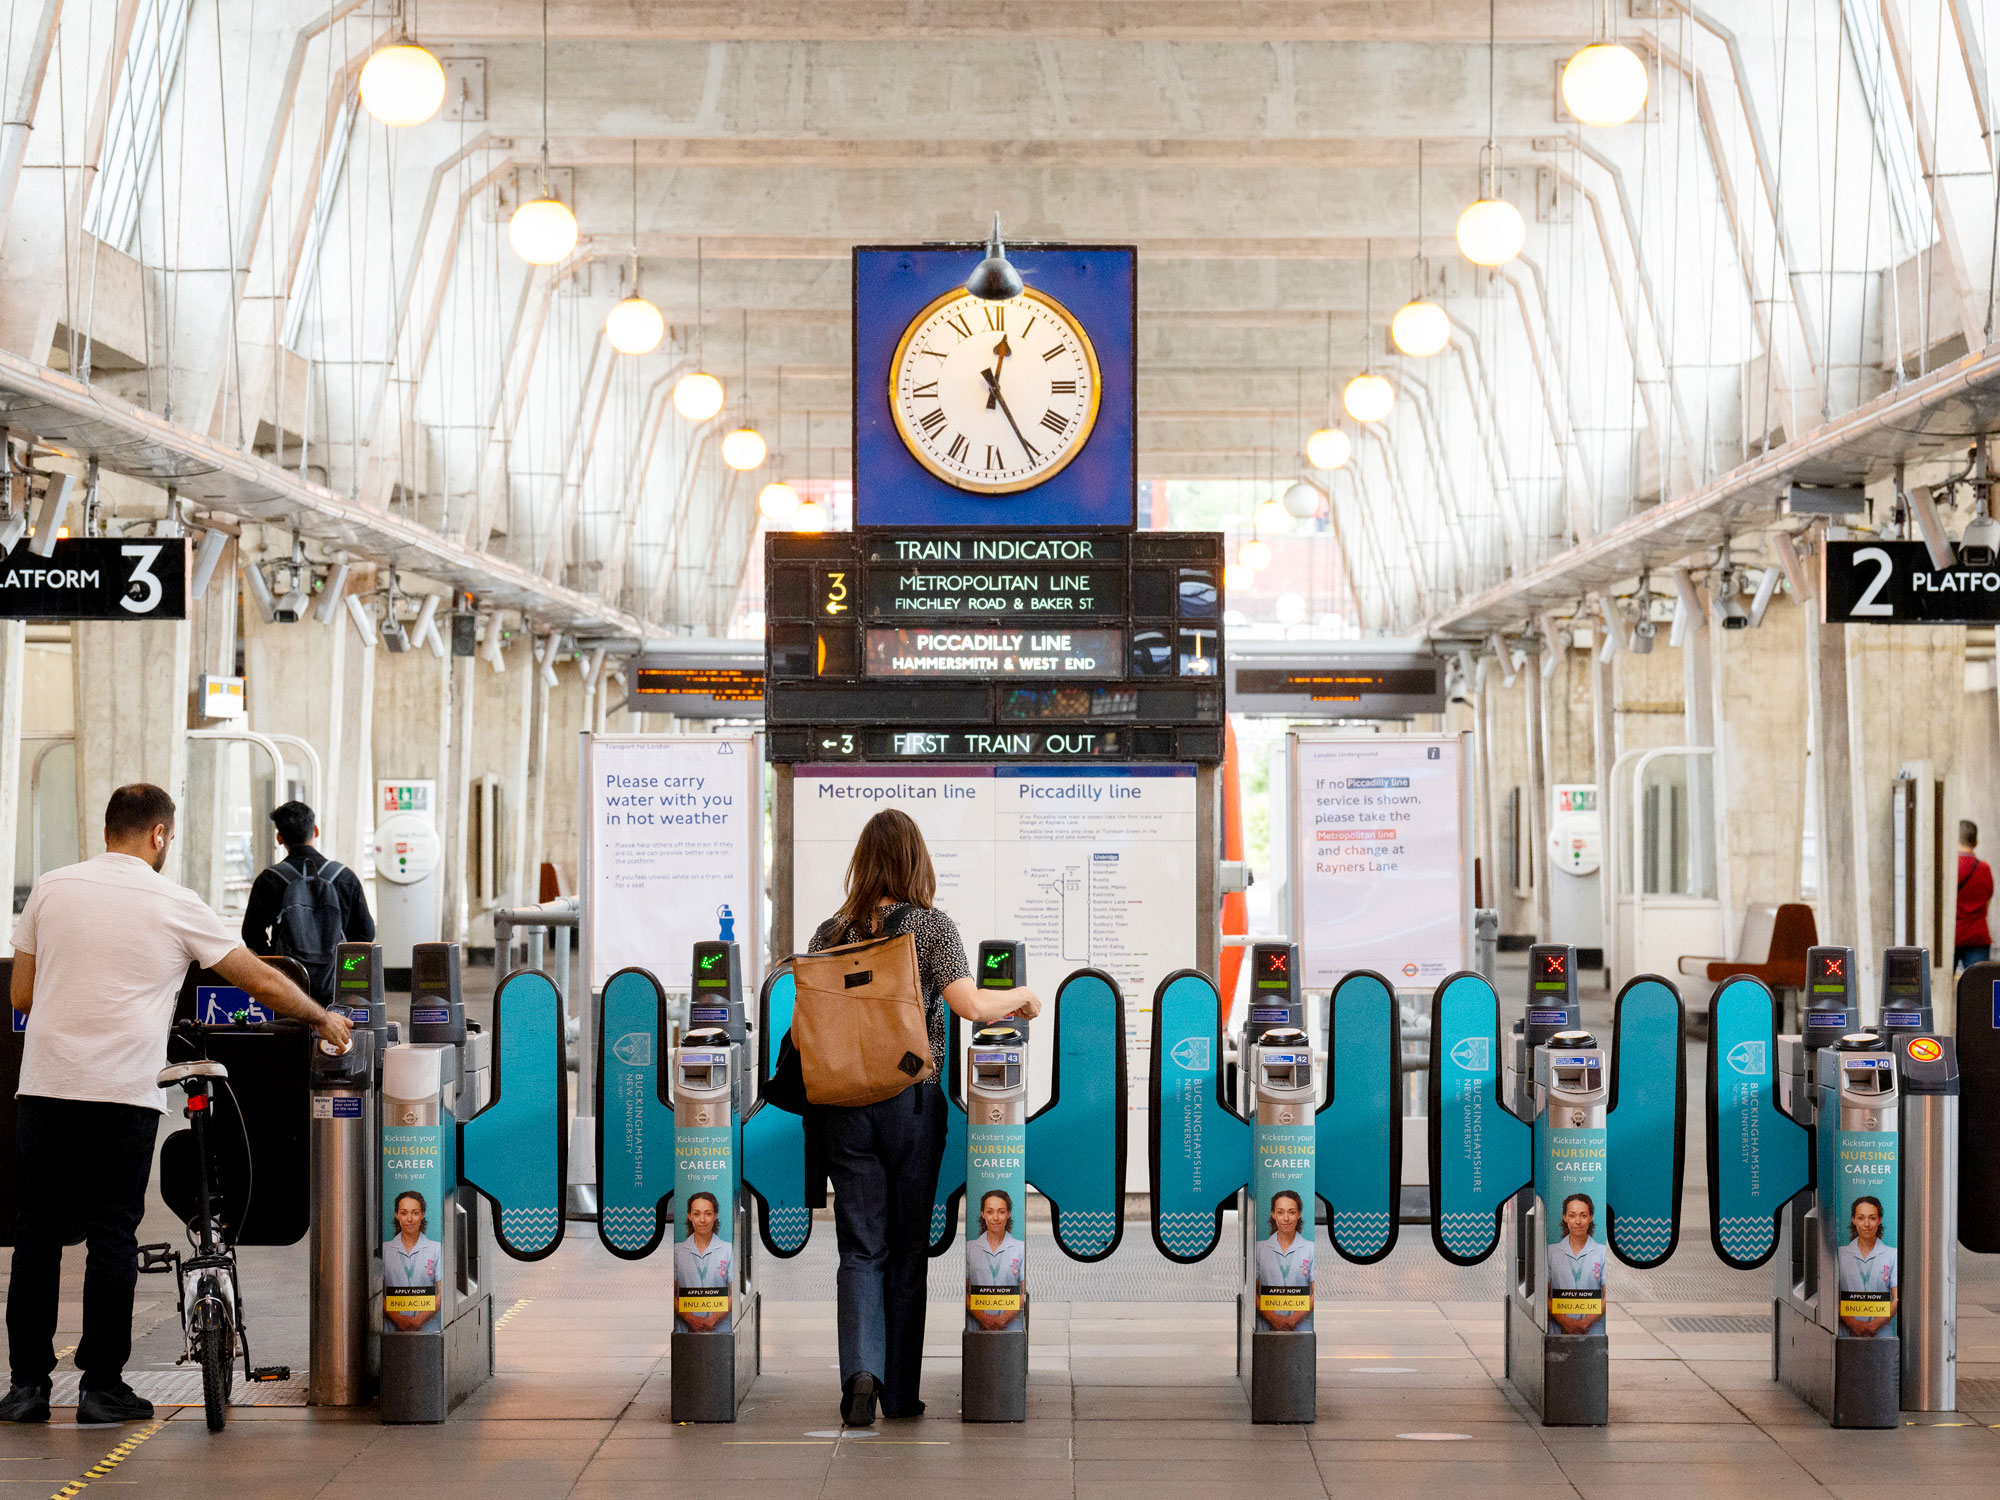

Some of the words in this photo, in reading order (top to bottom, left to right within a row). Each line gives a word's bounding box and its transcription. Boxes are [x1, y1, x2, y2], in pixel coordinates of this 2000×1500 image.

[982, 306, 1004, 332] XII
[947, 313, 974, 344] XI
[1021, 316, 1039, 339] I
[920, 342, 947, 368] X
[1042, 343, 1067, 362] II
[912, 378, 938, 399] IX
[1051, 380, 1076, 394] III
[919, 408, 949, 440] VIII
[1038, 408, 1071, 436] IIII
[947, 433, 971, 464] VII
[984, 444, 1005, 470] VI
[895, 540, 961, 560] TRAIN
[974, 540, 1094, 560] INDICATOR
[119, 544, 164, 614] 3
[900, 575, 1038, 591] METROPOLITAN
[1050, 575, 1090, 591] LINE
[1849, 547, 1894, 616] 2
[1912, 572, 2000, 592] PLATFO
[827, 572, 848, 601] 3
[895, 597, 962, 610] FINCHLEY
[968, 597, 1007, 610] ROAD
[1013, 597, 1024, 610] &
[1030, 597, 1073, 610] BAKER
[1078, 597, 1095, 610] ST.
[917, 635, 1022, 651] PICCADILLY
[1031, 635, 1072, 651] LINE
[892, 657, 998, 670] HAMMERSMITH
[1003, 657, 1014, 670] &
[1018, 657, 1058, 670] WEST
[1064, 657, 1095, 670] END
[841, 734, 854, 753] 3
[894, 734, 950, 753] FIRST
[964, 734, 1031, 753] TRAIN
[1046, 734, 1096, 753] OUT
[606, 775, 659, 788] Please
[664, 776, 705, 790] carry
[1316, 778, 1326, 789] If
[1329, 781, 1344, 789] no
[1348, 778, 1389, 788] Piccadilly
[1391, 778, 1408, 787] line
[818, 784, 937, 802] Metropolitan
[944, 784, 976, 799] line
[1019, 784, 1102, 802] Piccadilly
[1110, 784, 1142, 799] line
[606, 795, 654, 806] water
[660, 793, 697, 806] with
[702, 795, 733, 808] you
[1316, 795, 1360, 806] service
[1364, 795, 1374, 805] is
[606, 812, 621, 825] in
[626, 812, 655, 825] hot
[660, 811, 729, 825] weather
[1315, 813, 1355, 824] please
[1358, 812, 1386, 821] take
[1390, 811, 1411, 821] the
[1317, 830, 1376, 841] Metropolitan
[1378, 830, 1395, 839] line
[1318, 845, 1340, 856] and
[1344, 845, 1388, 857] change
[1392, 845, 1405, 855] at
[1316, 862, 1365, 875] Rayners
[1368, 861, 1398, 872] Lane
[714, 1055, 725, 1063] 44
[1007, 1054, 1018, 1062] 43
[625, 1073, 633, 1094] NEW
[625, 1099, 633, 1155] UNIVERSITY
[635, 1073, 643, 1188] BUCKINGHAMSHIRE
[1183, 1104, 1191, 1160] UNIVERSITY
[1463, 1104, 1471, 1160] UNIVERSITY
[384, 1134, 417, 1142] Kickstart
[419, 1135, 437, 1144] your
[677, 1135, 710, 1143] Kickstart
[711, 1136, 729, 1144] your
[1006, 1134, 1023, 1142] your
[1193, 1078, 1202, 1193] BUCKINGHAMSHIRE
[1261, 1133, 1295, 1141] Kickstart
[1297, 1135, 1313, 1143] your
[1473, 1078, 1482, 1193] BUCKINGHAMSHIRE
[1553, 1137, 1586, 1145] Kickstart
[1588, 1138, 1605, 1146] your
[1741, 1108, 1749, 1164] UNIVERSITY
[1750, 1082, 1760, 1197] BUCKINGHAMSHIRE
[383, 1146, 438, 1155] NURSING
[676, 1146, 730, 1156] NURSING
[970, 1145, 1024, 1154] NURSING
[1260, 1145, 1315, 1155] NURSING
[1842, 1139, 1876, 1147] Kickstart
[1878, 1140, 1894, 1149] your
[1551, 1149, 1606, 1158] NURSING
[1841, 1151, 1896, 1161] NURSING
[387, 1159, 434, 1169] CAREER
[680, 1160, 727, 1169] CAREER
[973, 1158, 1020, 1168] CAREER
[1264, 1159, 1311, 1168] CAREER
[1555, 1162, 1602, 1171] CAREER
[1844, 1164, 1891, 1174] CAREER
[394, 1172, 408, 1180] this
[410, 1173, 427, 1181] year
[703, 1174, 719, 1182] year
[997, 1172, 1013, 1180] year
[1271, 1171, 1285, 1179] this
[1287, 1172, 1304, 1180] year
[1852, 1177, 1866, 1185] this
[1868, 1178, 1884, 1186] year
